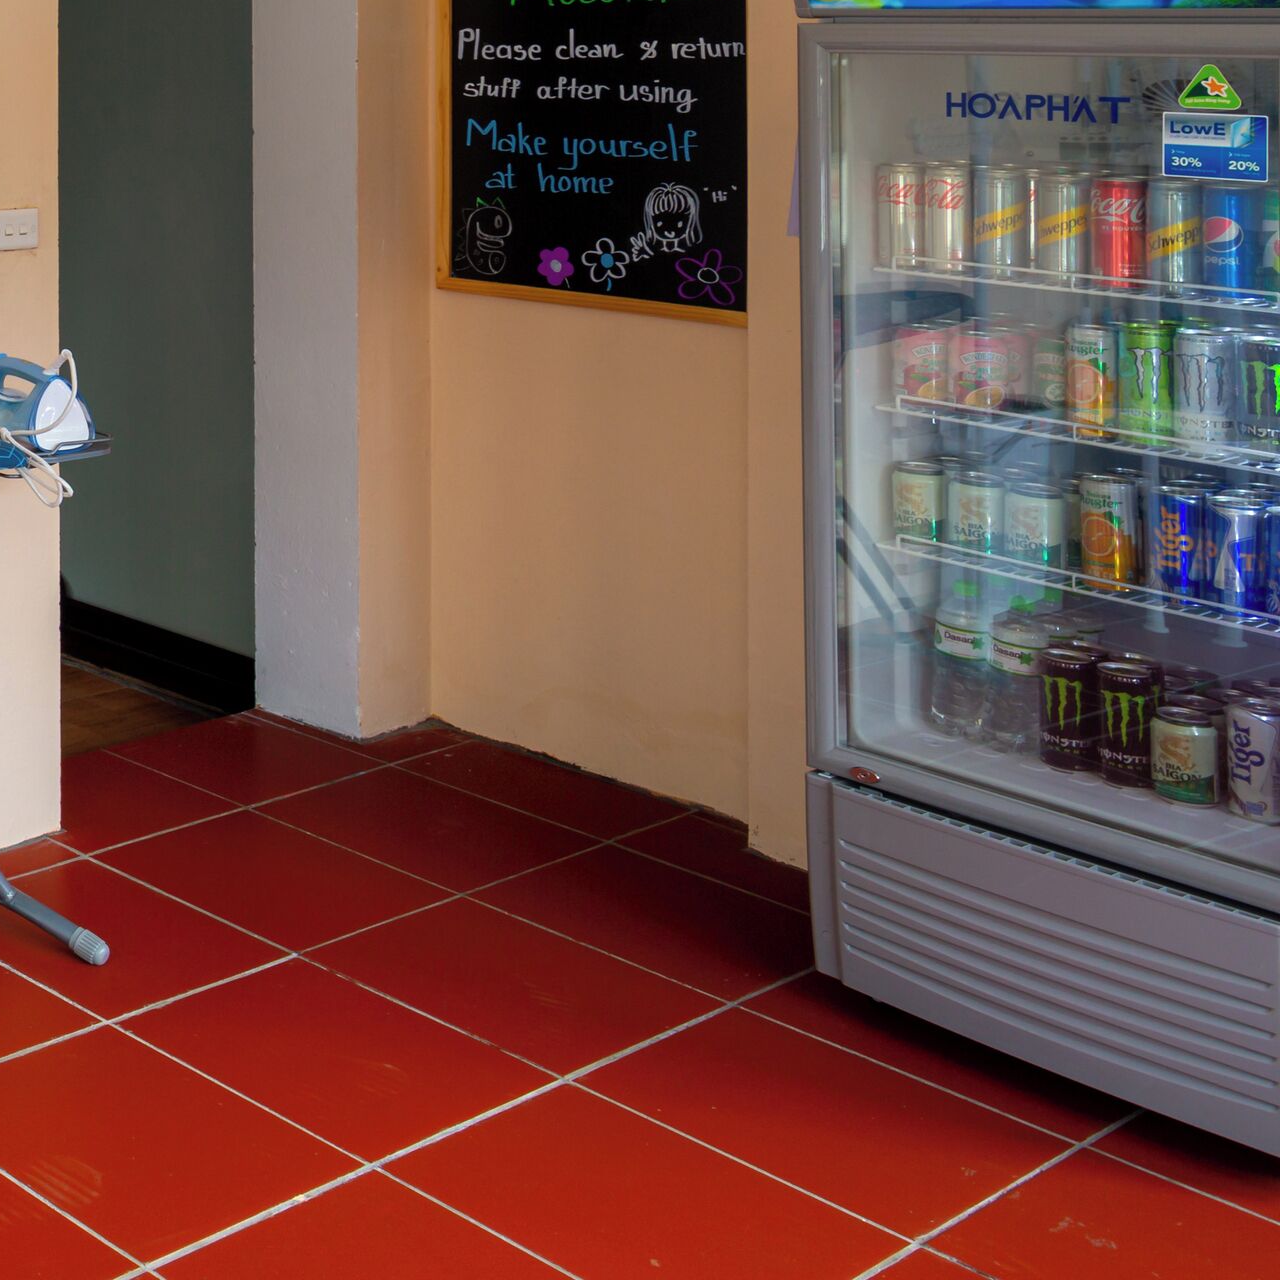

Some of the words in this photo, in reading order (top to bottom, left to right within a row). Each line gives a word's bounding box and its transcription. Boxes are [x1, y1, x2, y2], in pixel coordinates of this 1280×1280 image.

[458, 28, 542, 61] Please
[555, 28, 624, 59] clean
[671, 37, 746, 60] return
[463, 75, 521, 99] stuff
[536, 76, 610, 100] after
[619, 80, 698, 114] using
[1169, 120, 1226, 136] LowE
[466, 118, 548, 156] Make
[558, 123, 699, 170] yourself
[1171, 155, 1202, 168] 30%
[1228, 160, 1260, 172] 20%
[485, 162, 518, 190] at
[537, 162, 615, 195] home
[1152, 763, 1202, 781] SAIGON
[1165, 762, 1182, 772] BIA
